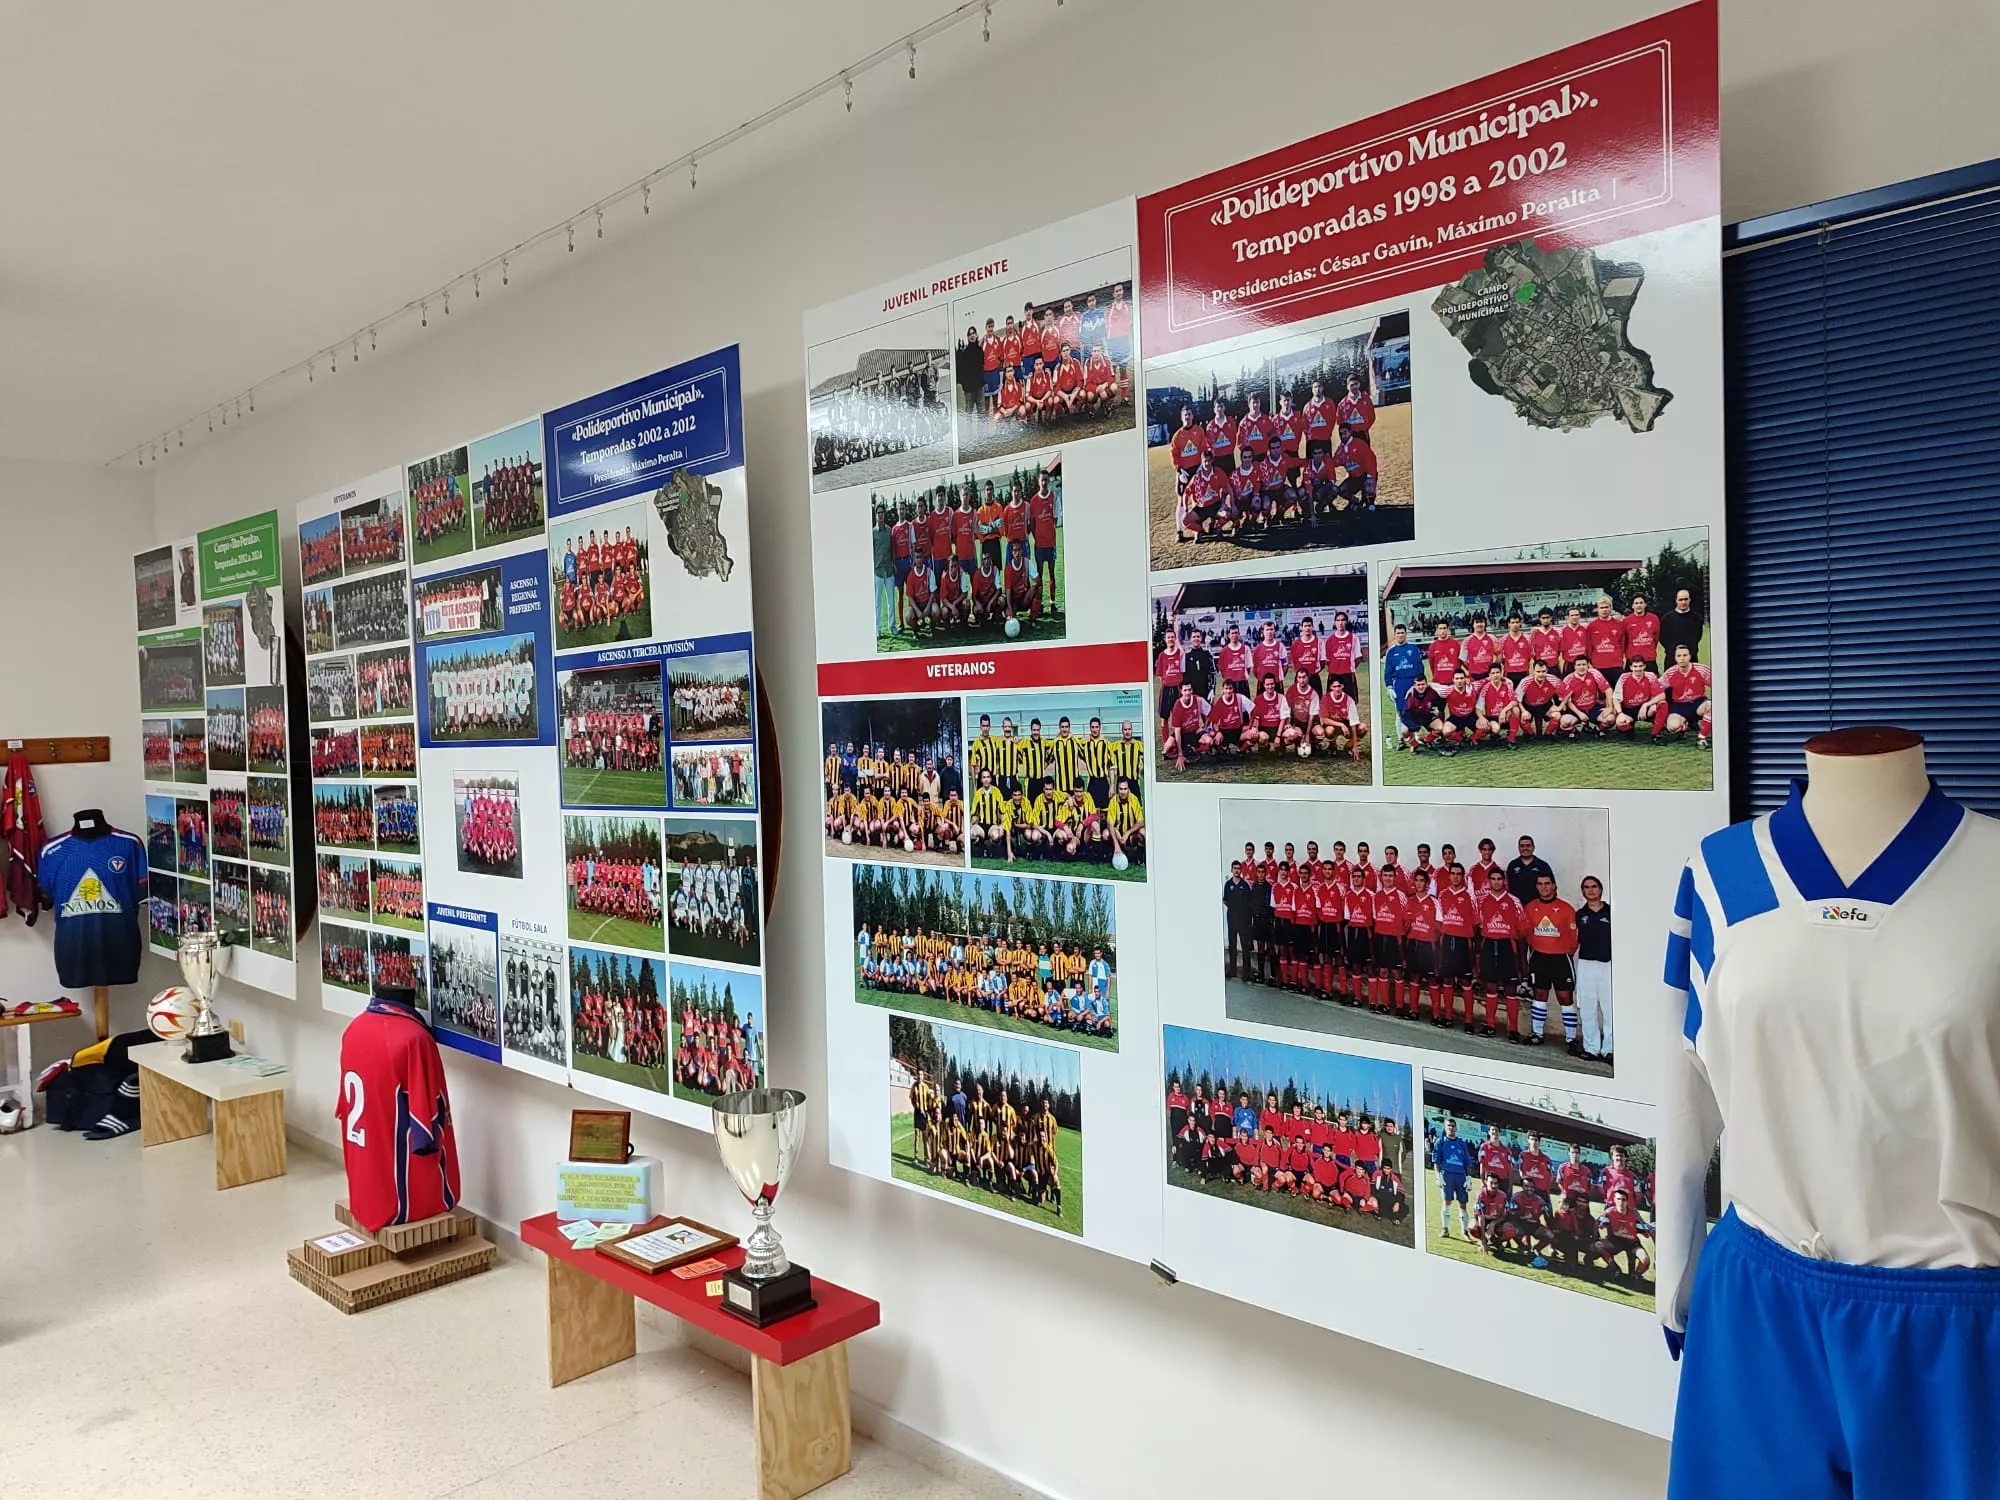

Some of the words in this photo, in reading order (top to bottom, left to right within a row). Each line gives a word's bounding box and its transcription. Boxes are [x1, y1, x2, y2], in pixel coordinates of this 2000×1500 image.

[1210, 149, 1403, 228] «Polideportivo
[1408, 85, 1599, 168] Municipal».
[1232, 205, 1387, 264] Temporadas
[1393, 177, 1457, 217] 1998
[1463, 174, 1481, 196] a
[1488, 142, 1568, 187] 2002
[1211, 266, 1318, 307] Presidencias:
[1320, 247, 1371, 277] César
[1374, 233, 1434, 264] Gavín,
[1437, 210, 1518, 252] Máximo
[1520, 184, 1601, 221] Peralta
[882, 287, 928, 312] JUVENIL
[931, 259, 1010, 295] PREFERENTE
[1477, 283, 1509, 296] CAMPO
[572, 408, 641, 441] «Polideportivo
[641, 384, 705, 420] Municipal».
[580, 437, 637, 465] Temporadas
[637, 428, 663, 447] 2002
[664, 428, 671, 438] a
[672, 415, 696, 436] 2012
[631, 457, 658, 474] Máximo
[658, 450, 683, 466] Peralta
[333, 490, 356, 504] VETERANOS
[509, 578, 533, 590] ASCENSO
[533, 577, 539, 586] A
[511, 590, 538, 602] REGIONAL
[508, 602, 541, 616] PREFERENTE
[597, 648, 626, 662] ASCENSO
[626, 648, 632, 659] A
[633, 644, 662, 658] TERCERA
[662, 639, 695, 654] DIVISIÓN
[926, 661, 995, 678] VETERANOS
[436, 906, 455, 919] JUVENIL
[456, 910, 487, 924] PREFERENTE
[511, 917, 533, 931] FÚTBOL
[533, 923, 548, 934] SALA
[343, 1070, 365, 1148] 2
